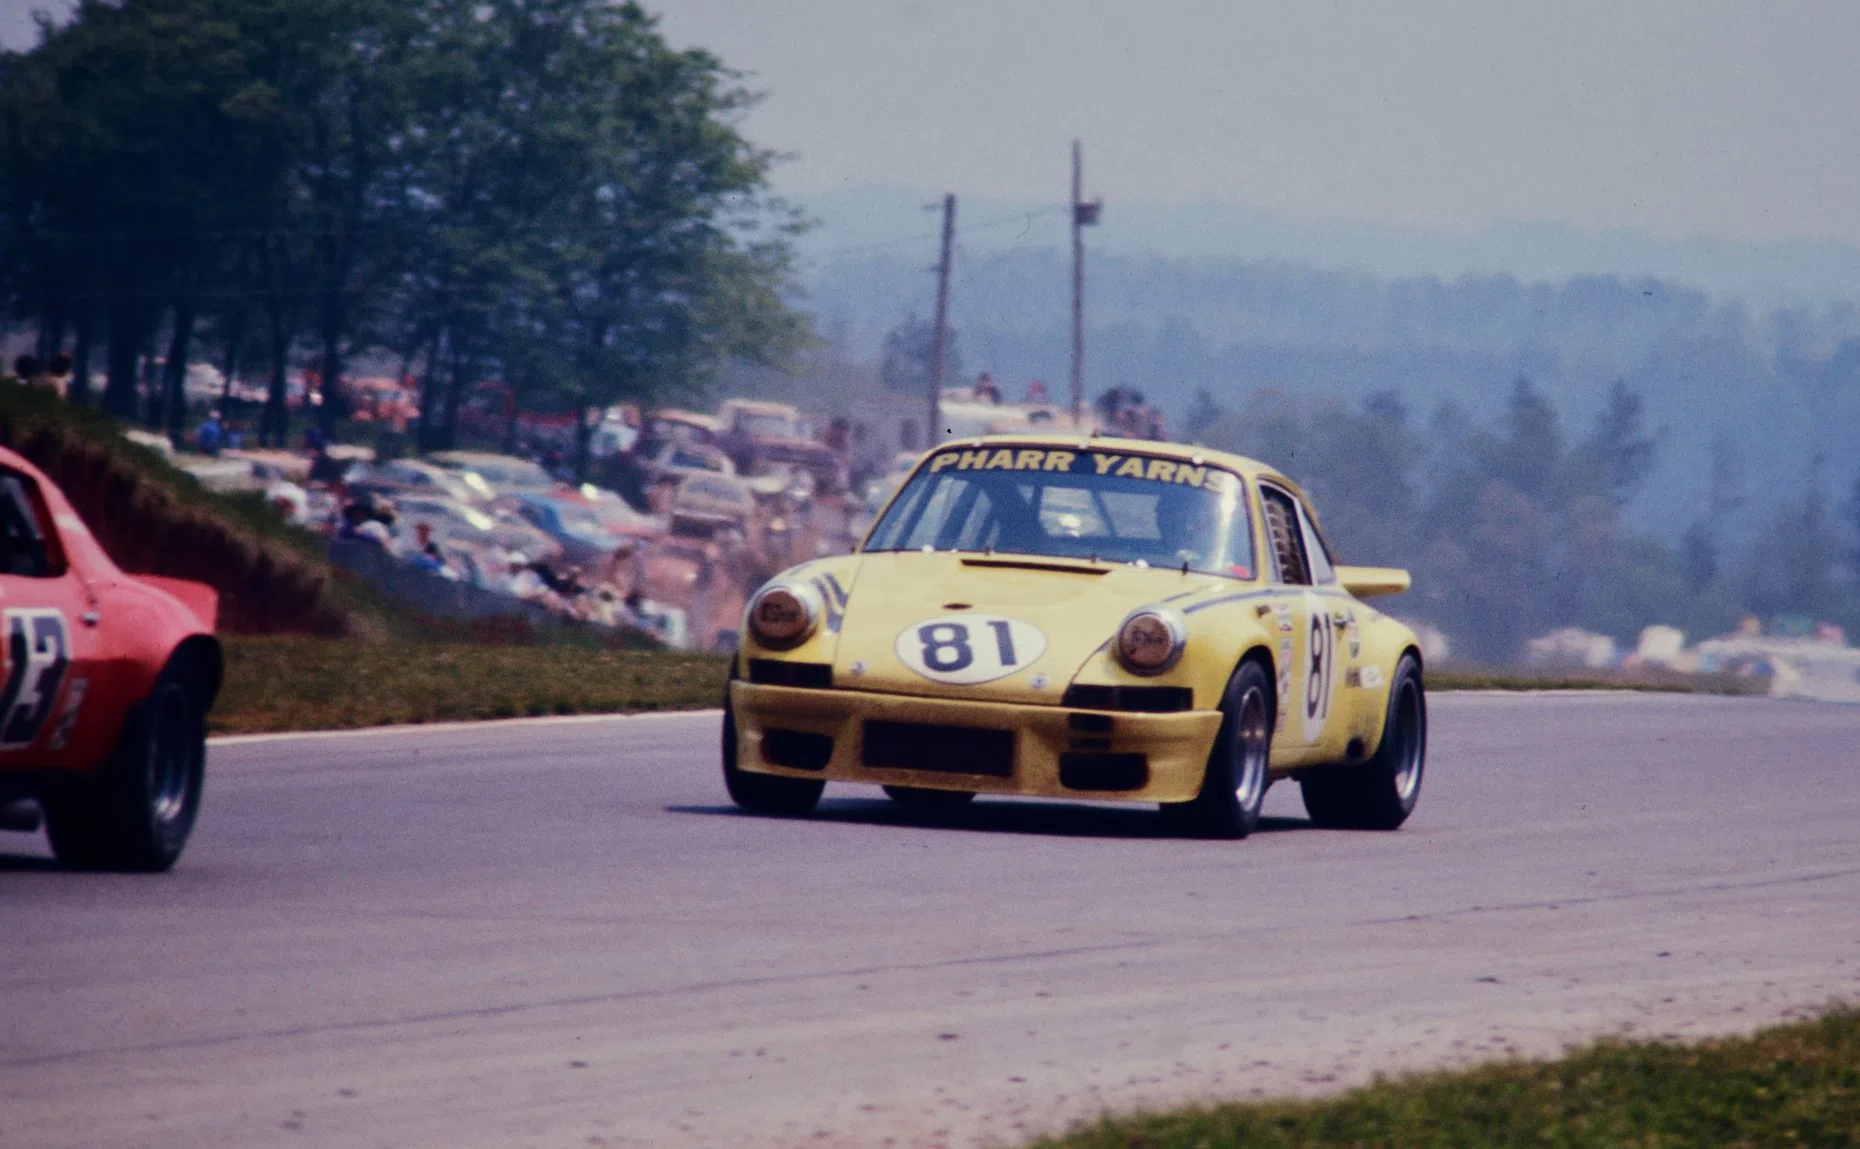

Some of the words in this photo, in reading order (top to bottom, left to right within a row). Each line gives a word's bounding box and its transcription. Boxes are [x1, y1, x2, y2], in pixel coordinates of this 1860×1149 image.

[930, 449, 1076, 473] PHARR
[1092, 453, 1226, 493] YARNS
[918, 620, 1018, 672] 81
[1307, 612, 1332, 719] 81
